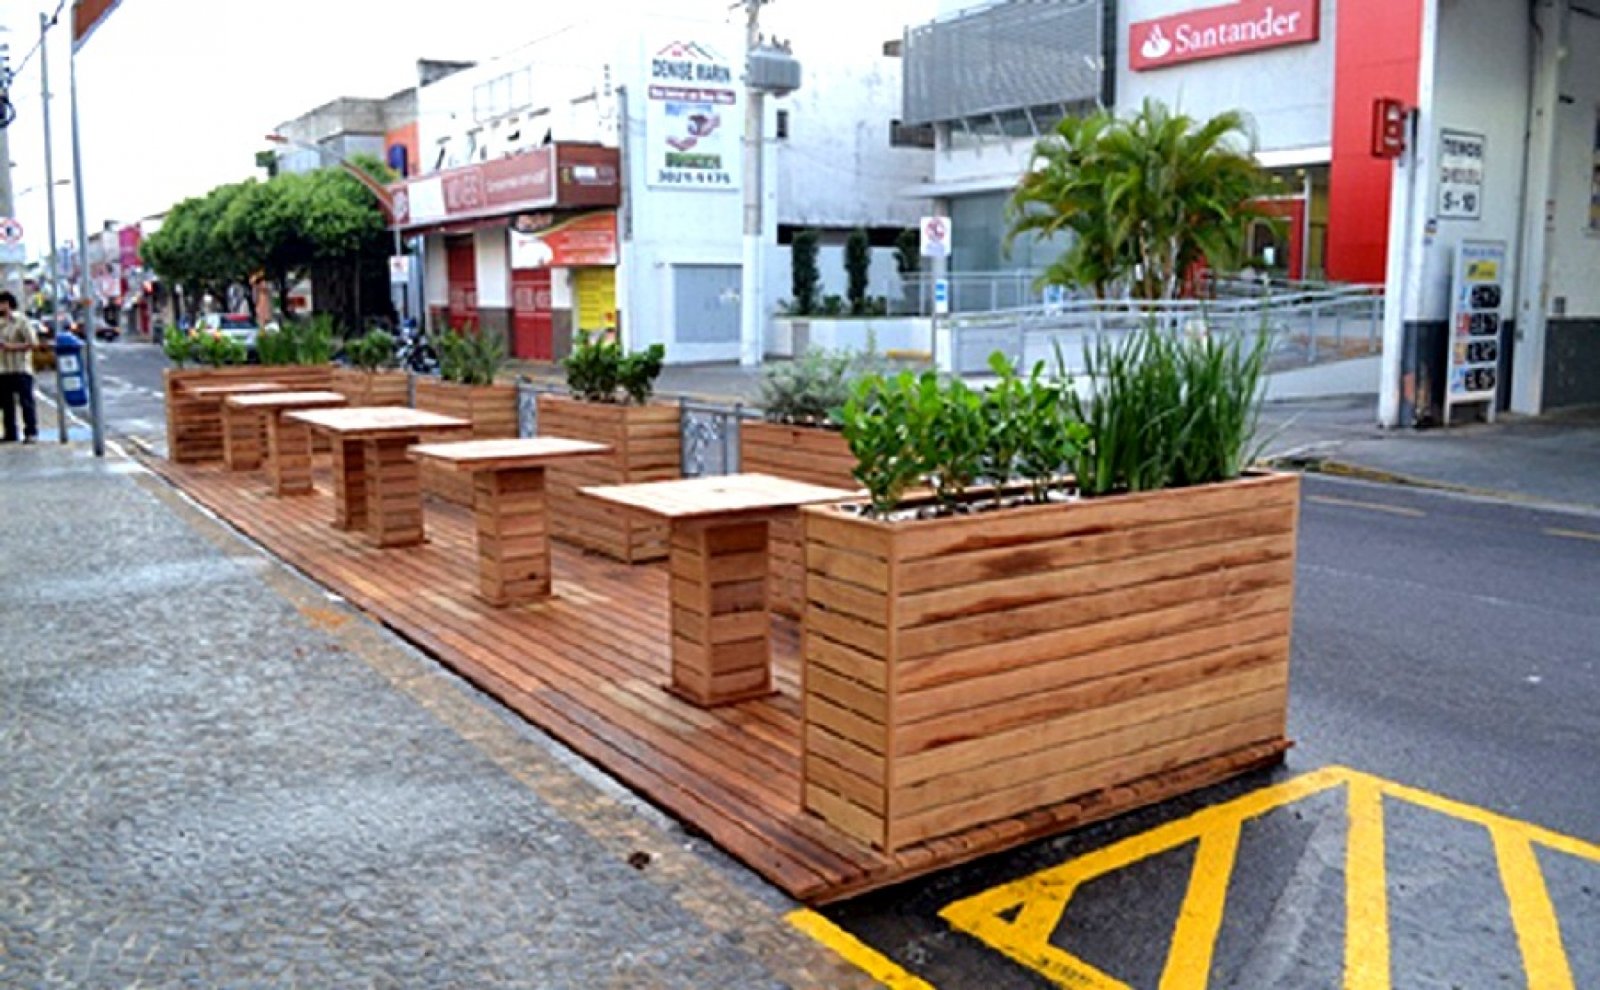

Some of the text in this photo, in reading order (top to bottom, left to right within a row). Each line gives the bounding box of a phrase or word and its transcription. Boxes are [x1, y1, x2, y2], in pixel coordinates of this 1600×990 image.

[1174, 7, 1300, 54] Santander
[652, 59, 731, 83] DENISE MARIN
